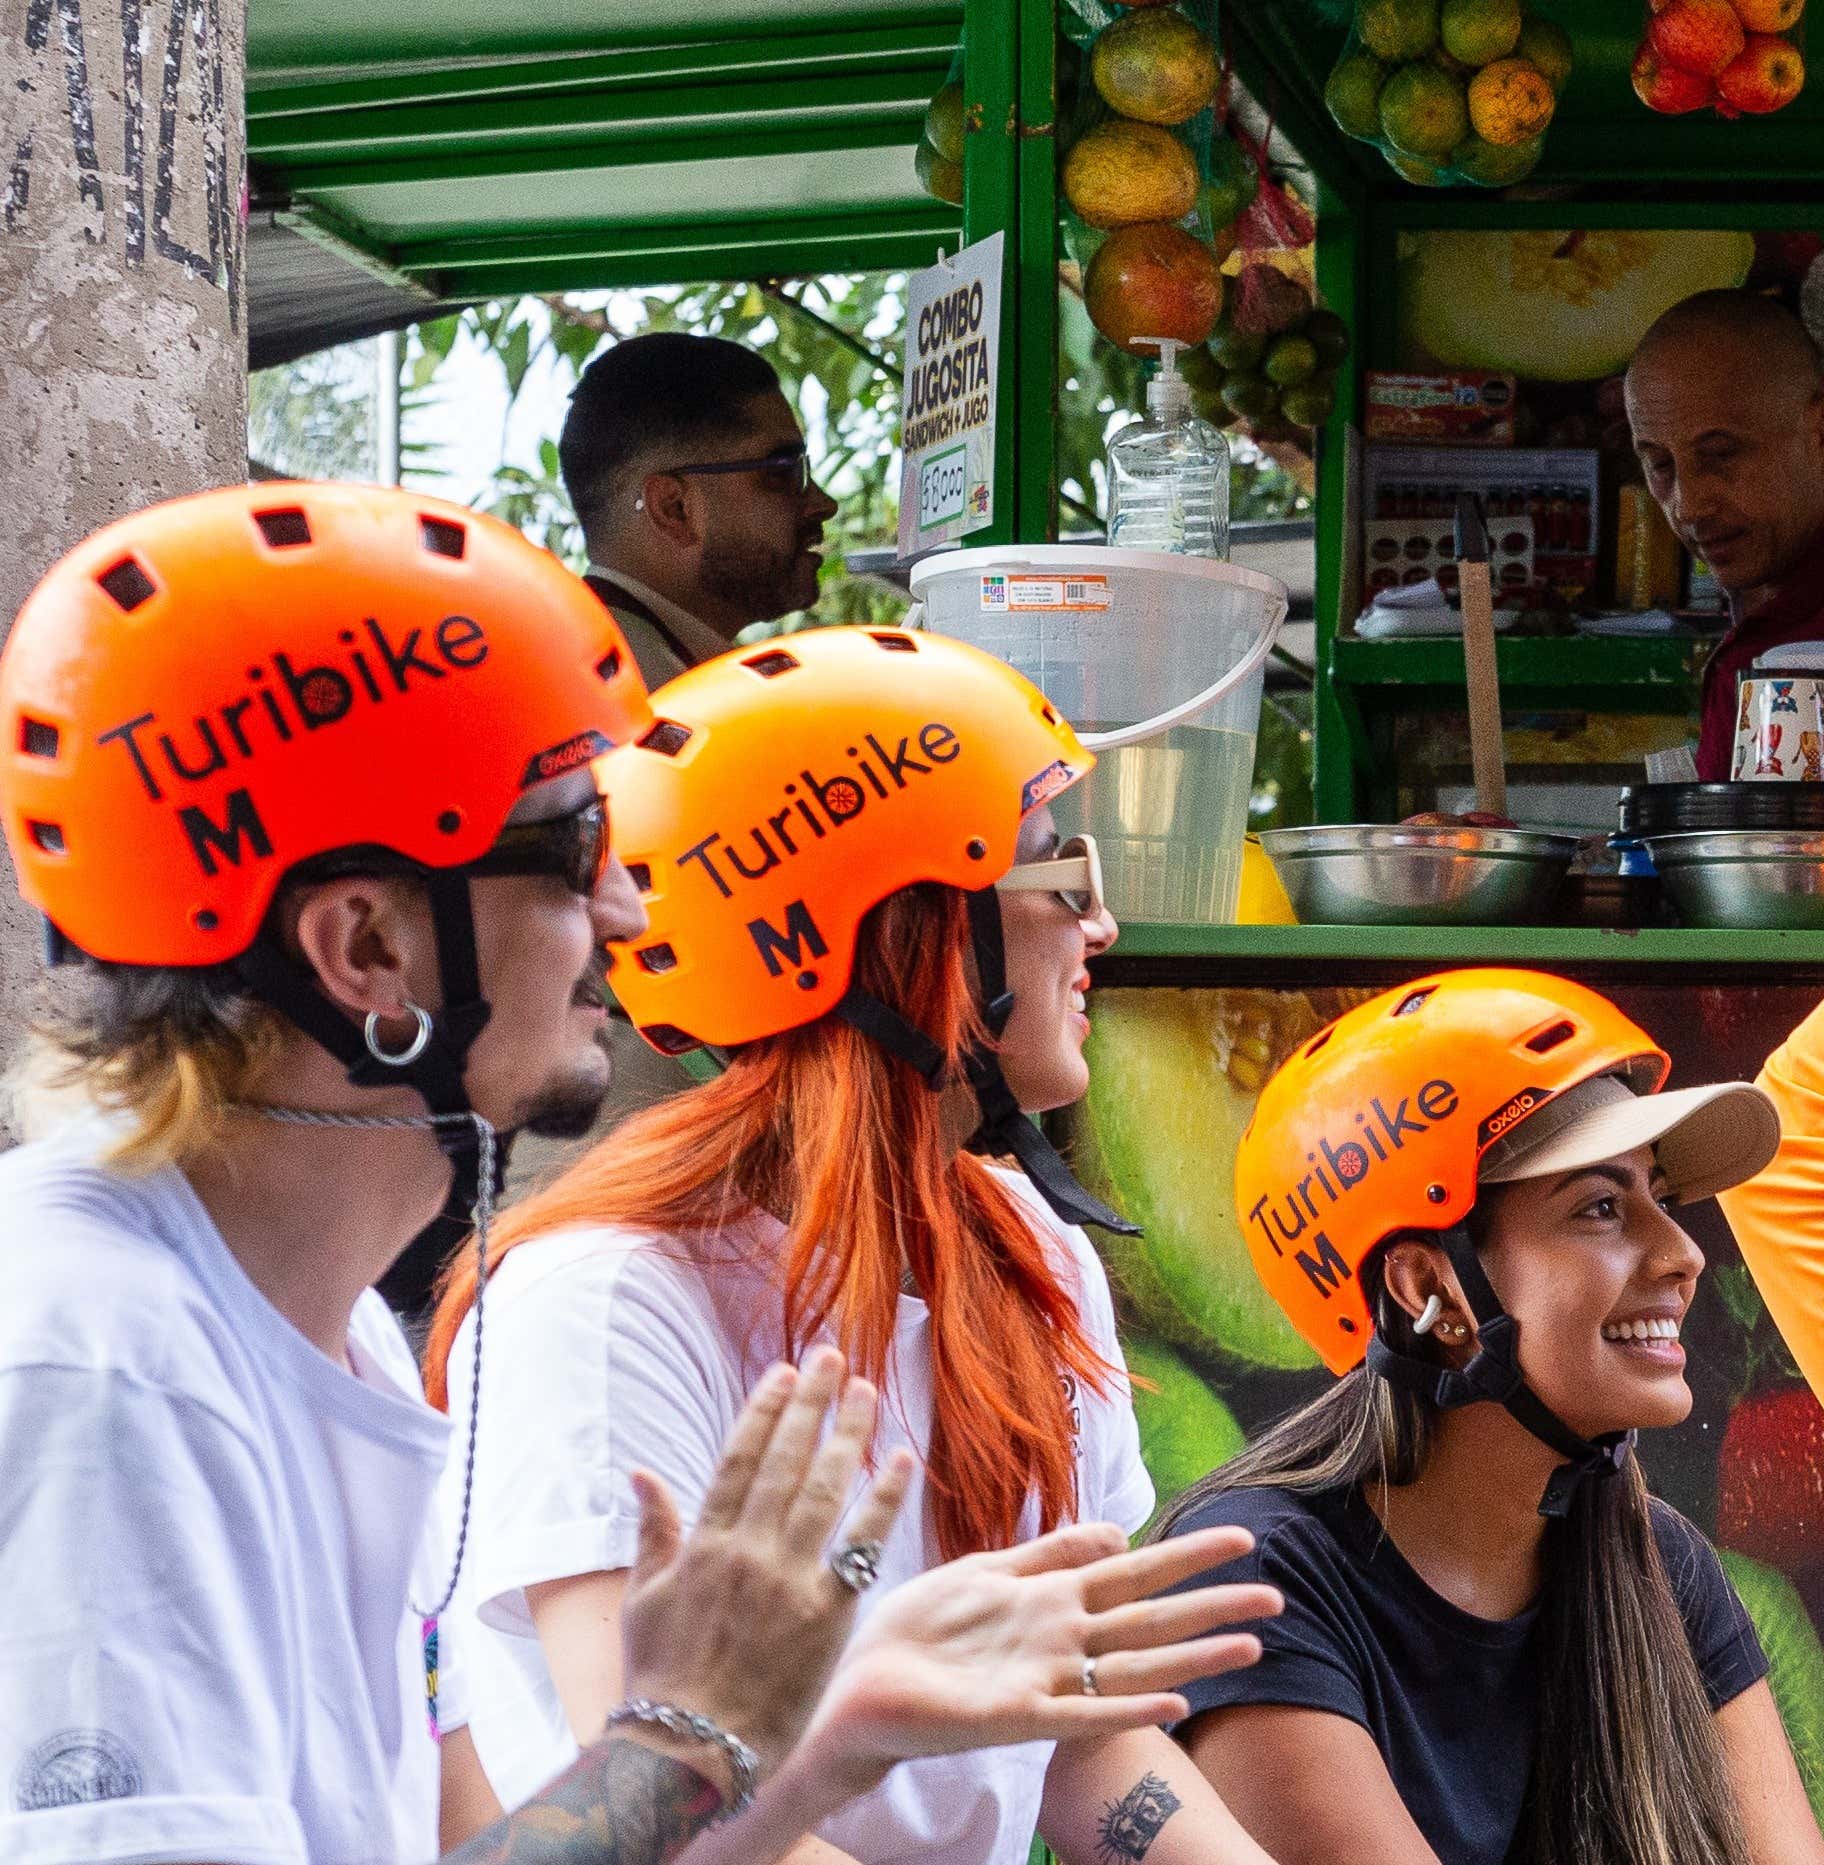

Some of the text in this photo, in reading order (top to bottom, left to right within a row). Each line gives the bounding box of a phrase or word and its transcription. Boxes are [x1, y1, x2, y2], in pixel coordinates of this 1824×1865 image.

[918, 281, 983, 357] COMBO
[906, 337, 989, 421] JUGOSITA
[904, 406, 953, 455] SANDWICH
[962, 392, 989, 430] JUGO
[97, 614, 489, 801] Turibike
[177, 787, 275, 877] M
[676, 722, 962, 899] Turibike
[745, 898, 830, 978] M
[1488, 1094, 1535, 1134] oxelo
[1249, 1078, 1460, 1258] Turibike
[1294, 1230, 1353, 1299] M
